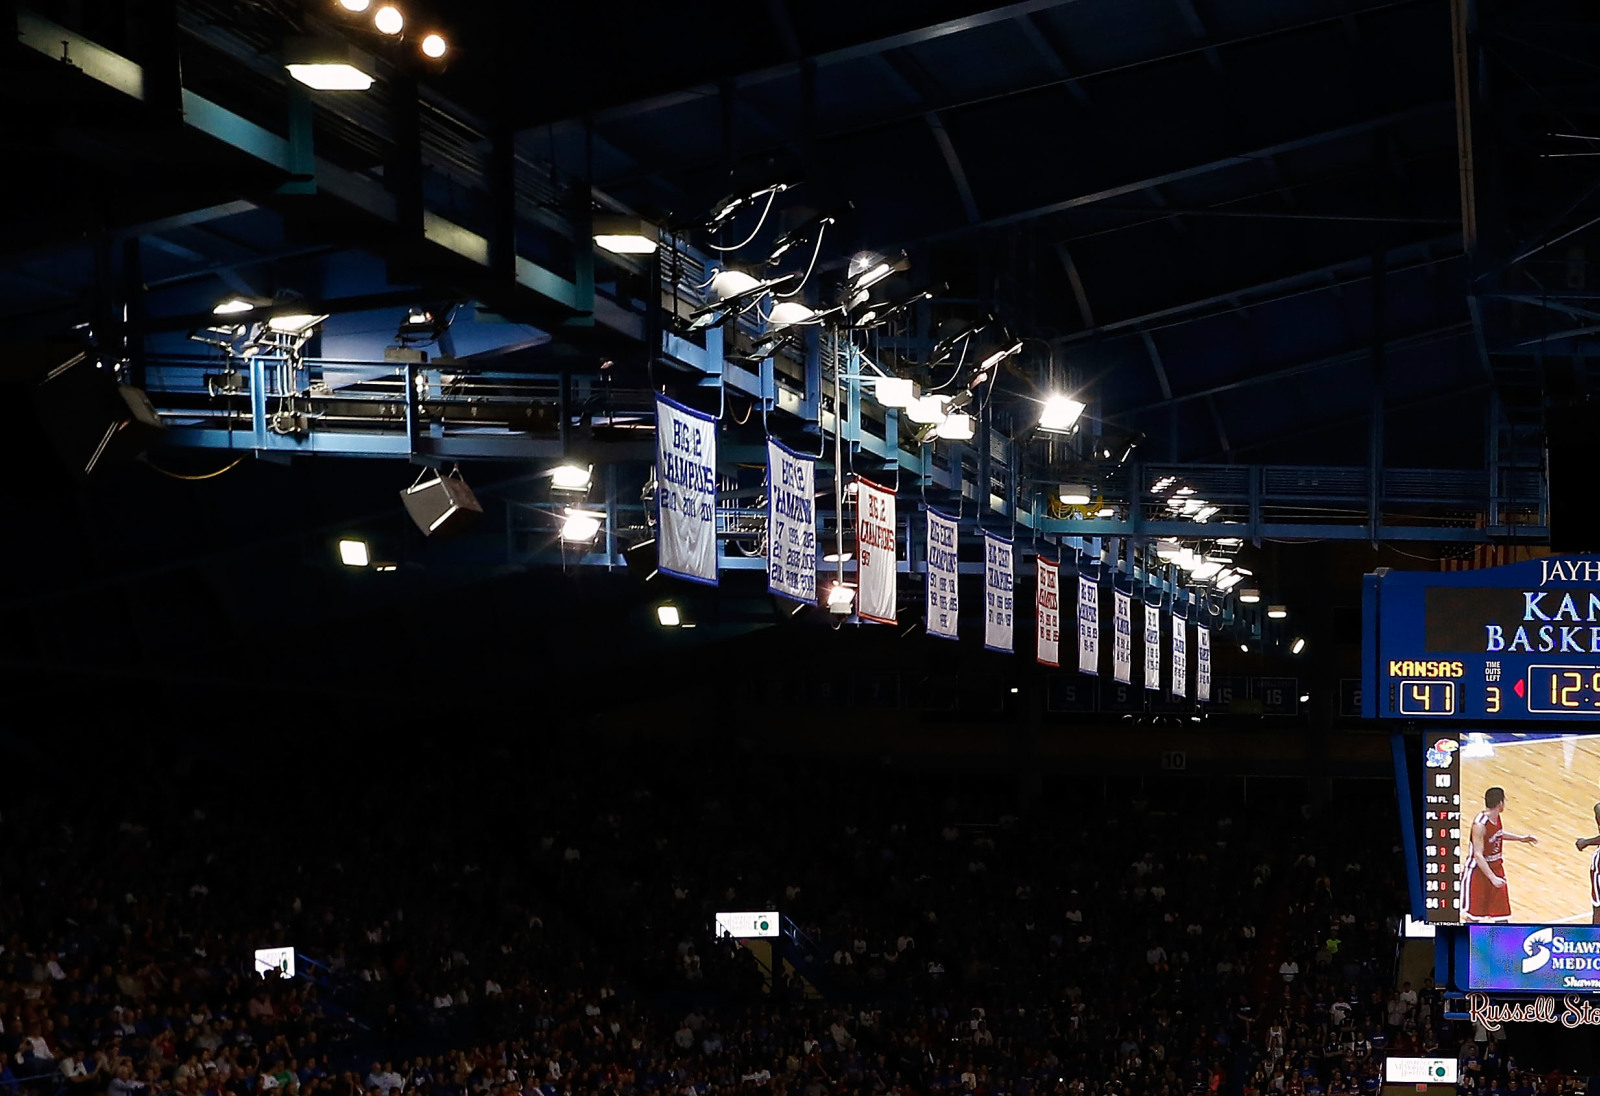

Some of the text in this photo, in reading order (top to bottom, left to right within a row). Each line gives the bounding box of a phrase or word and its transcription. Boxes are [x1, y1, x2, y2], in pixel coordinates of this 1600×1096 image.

[1389, 661, 1464, 677] KANSAS
[1485, 674, 1501, 682] LEFT
[1412, 685, 1451, 711] 41
[1486, 686, 1501, 713] 3
[1436, 774, 1451, 786] KU
[1440, 899, 1446, 908] 1
[1465, 991, 1558, 1031] Russell
